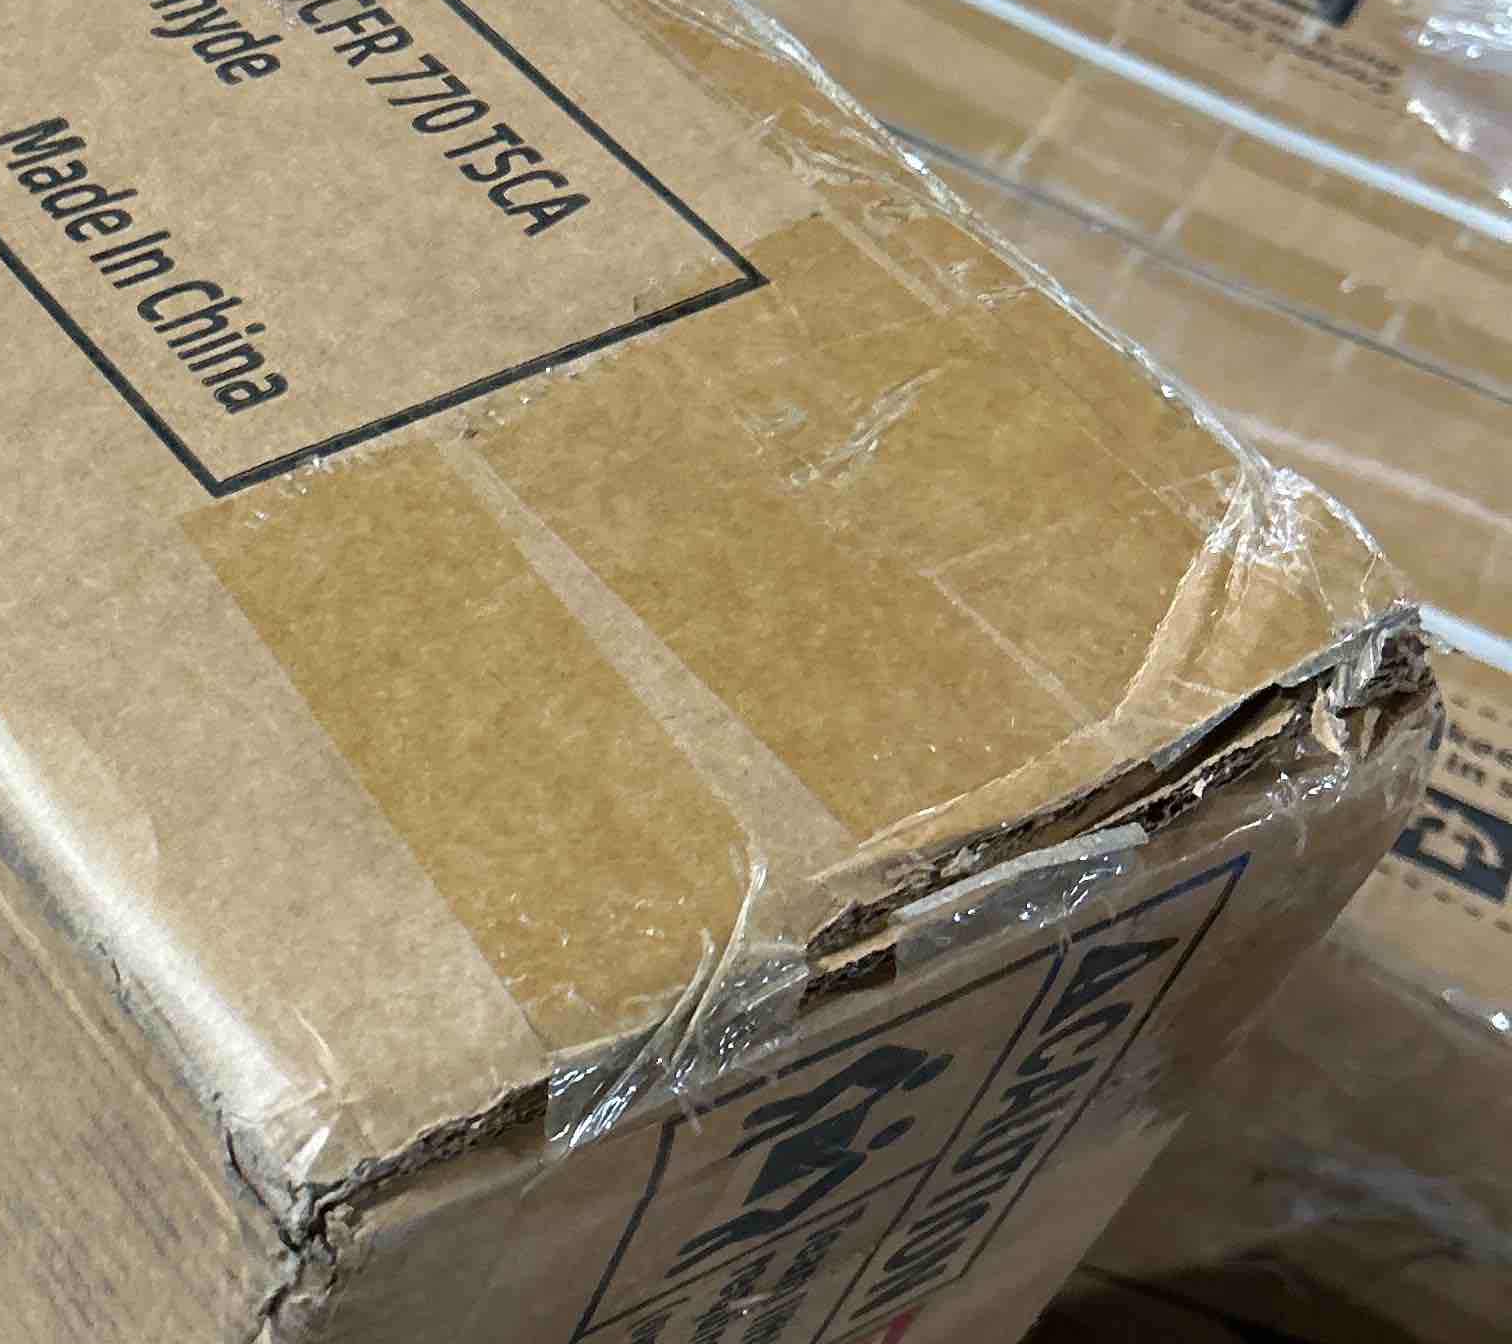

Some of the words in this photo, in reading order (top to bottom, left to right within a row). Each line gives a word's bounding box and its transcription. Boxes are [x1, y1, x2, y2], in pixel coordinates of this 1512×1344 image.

[367, 51, 489, 136] 770
[442, 123, 592, 239] TSCA
[133, 273, 289, 415] China
[849, 1000, 1135, 1323] CAUTION
